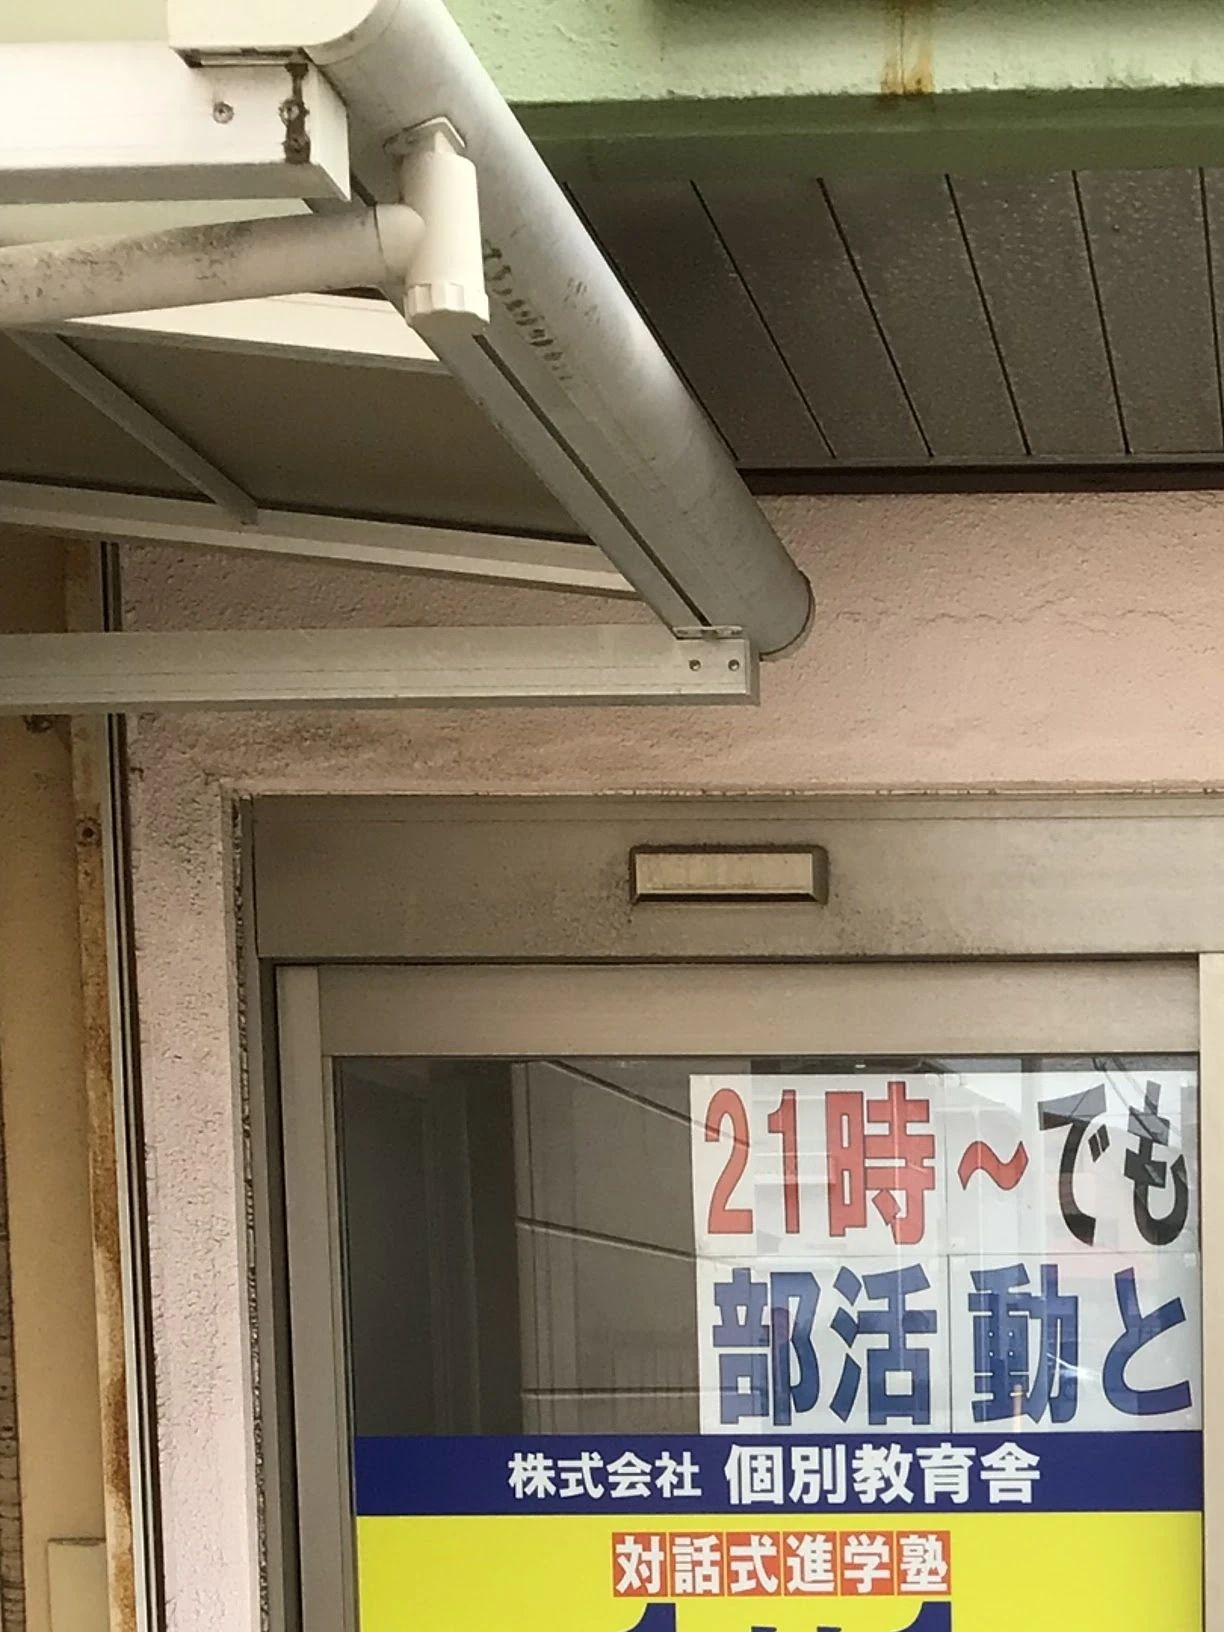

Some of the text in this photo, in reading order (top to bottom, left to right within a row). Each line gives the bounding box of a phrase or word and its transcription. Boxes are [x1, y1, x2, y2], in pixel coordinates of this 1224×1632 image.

[711, 1261, 1194, 1426] 部活動と
[507, 1442, 1042, 1505] 株式会社 個別教育舎
[613, 1532, 951, 1597] 対話式進学塾
